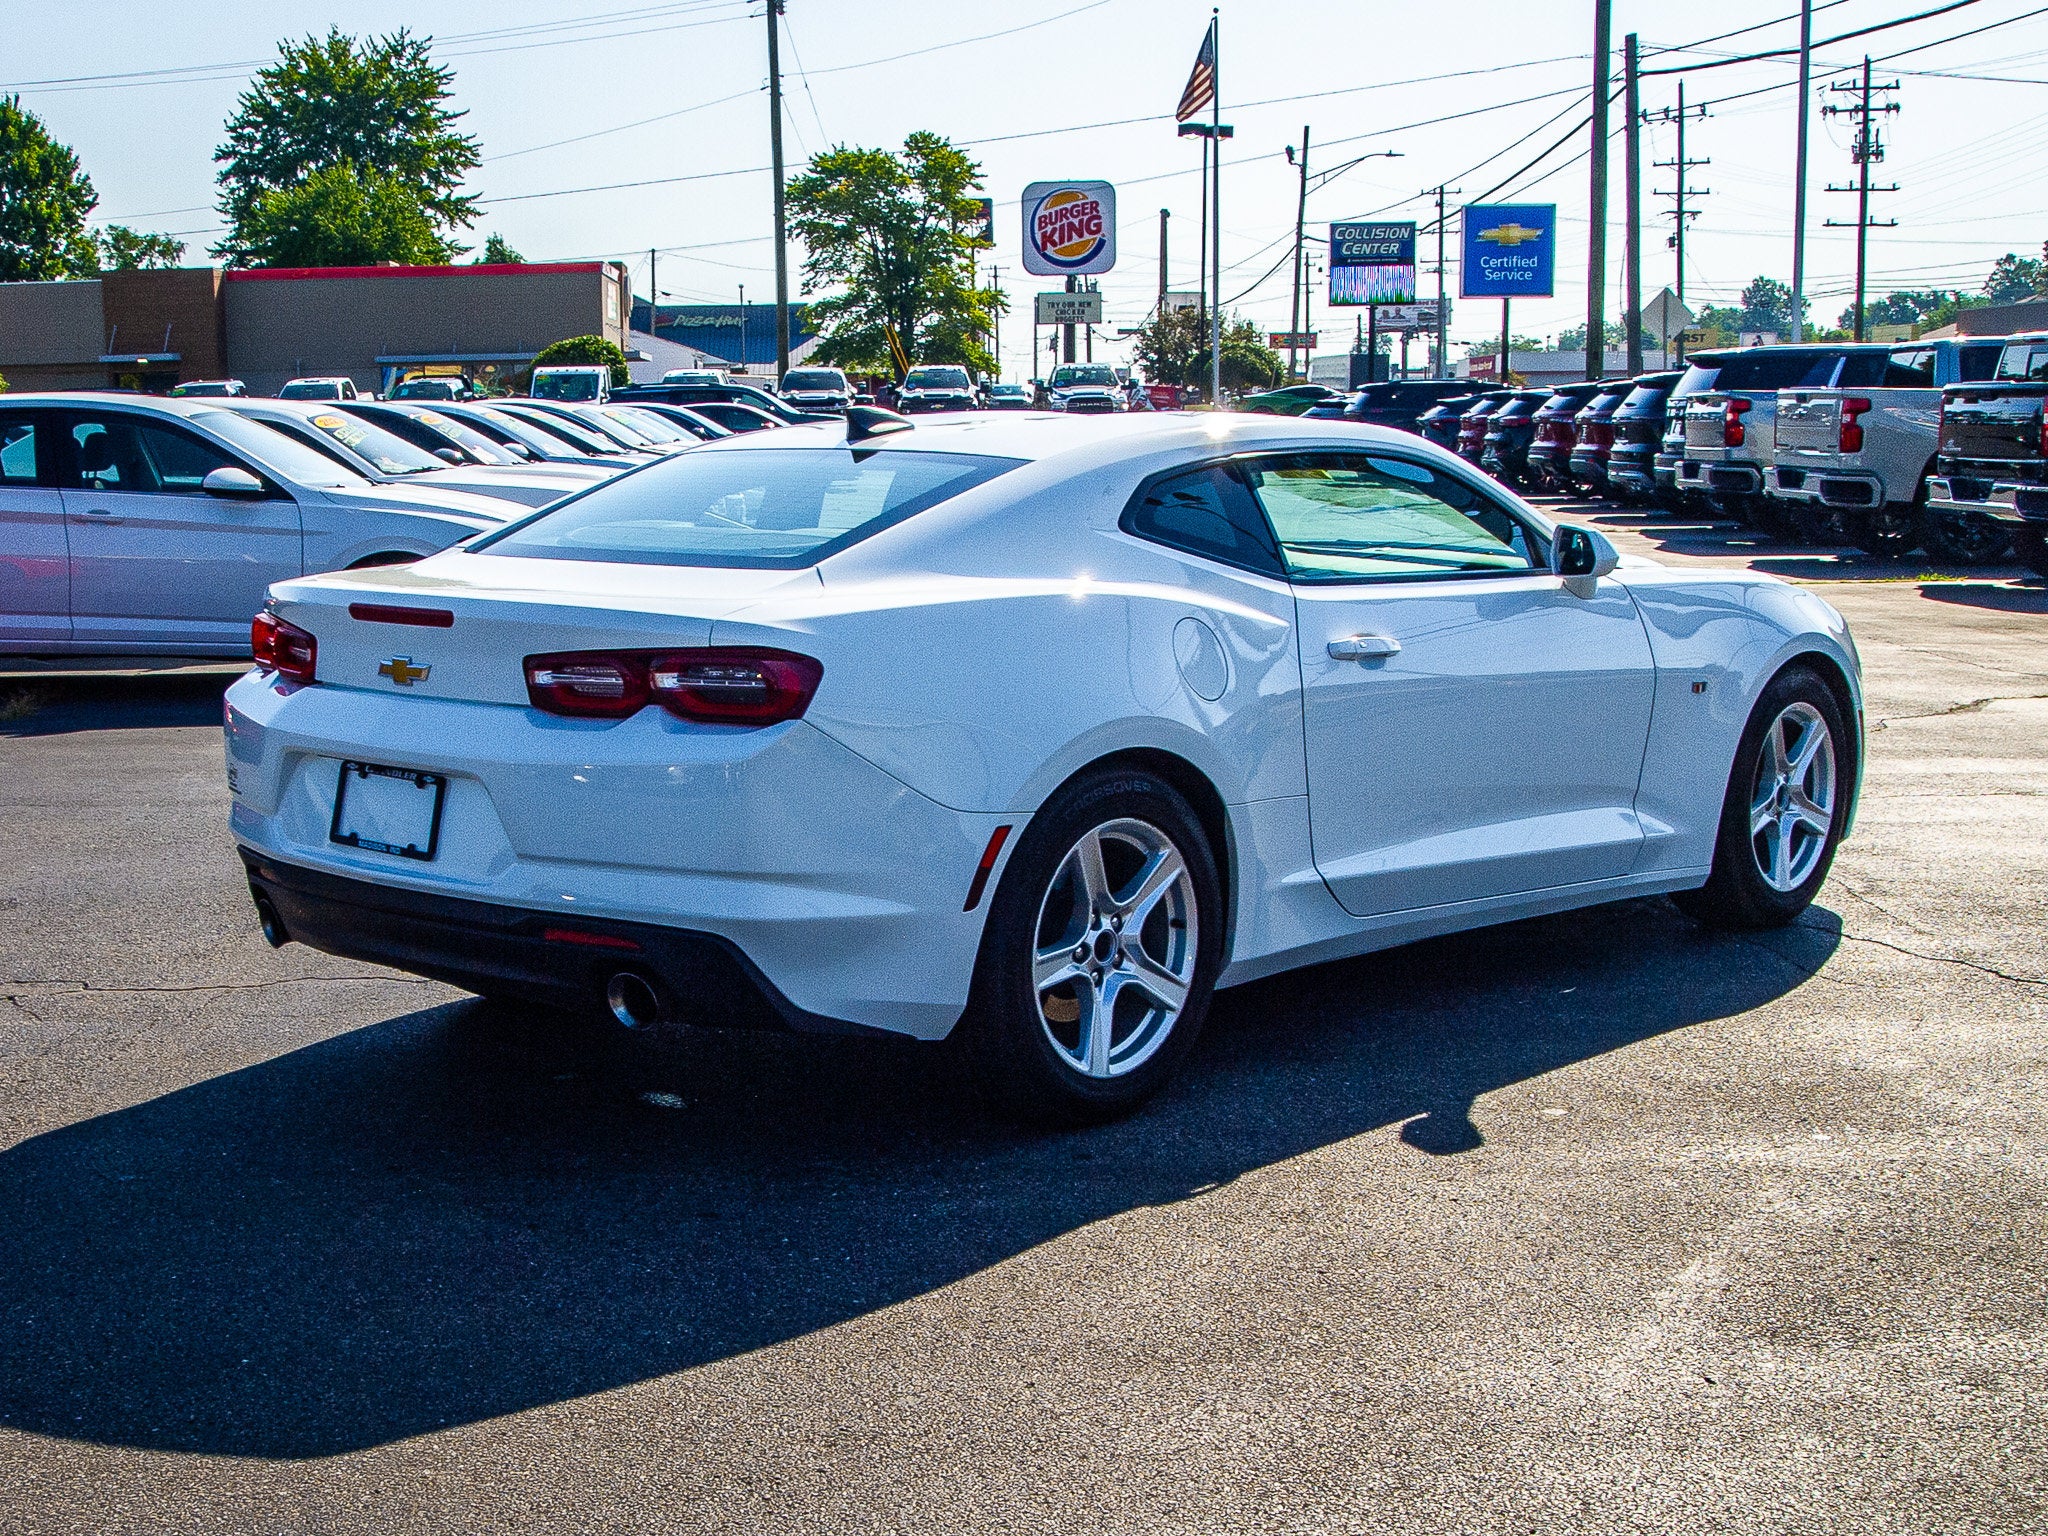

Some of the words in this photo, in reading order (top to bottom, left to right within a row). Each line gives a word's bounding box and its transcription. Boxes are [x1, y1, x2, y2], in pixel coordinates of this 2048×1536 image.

[1037, 200, 1100, 232] BURGER
[1040, 214, 1103, 253] KING
[1334, 226, 1411, 240] COLLISION
[1341, 242, 1400, 255] CENTER
[1480, 255, 1538, 268] Certified
[1484, 268, 1533, 281] Service
[1046, 301, 1060, 309] TRY
[1055, 308, 1086, 316] CHICKEN
[673, 314, 714, 328] Pizza
